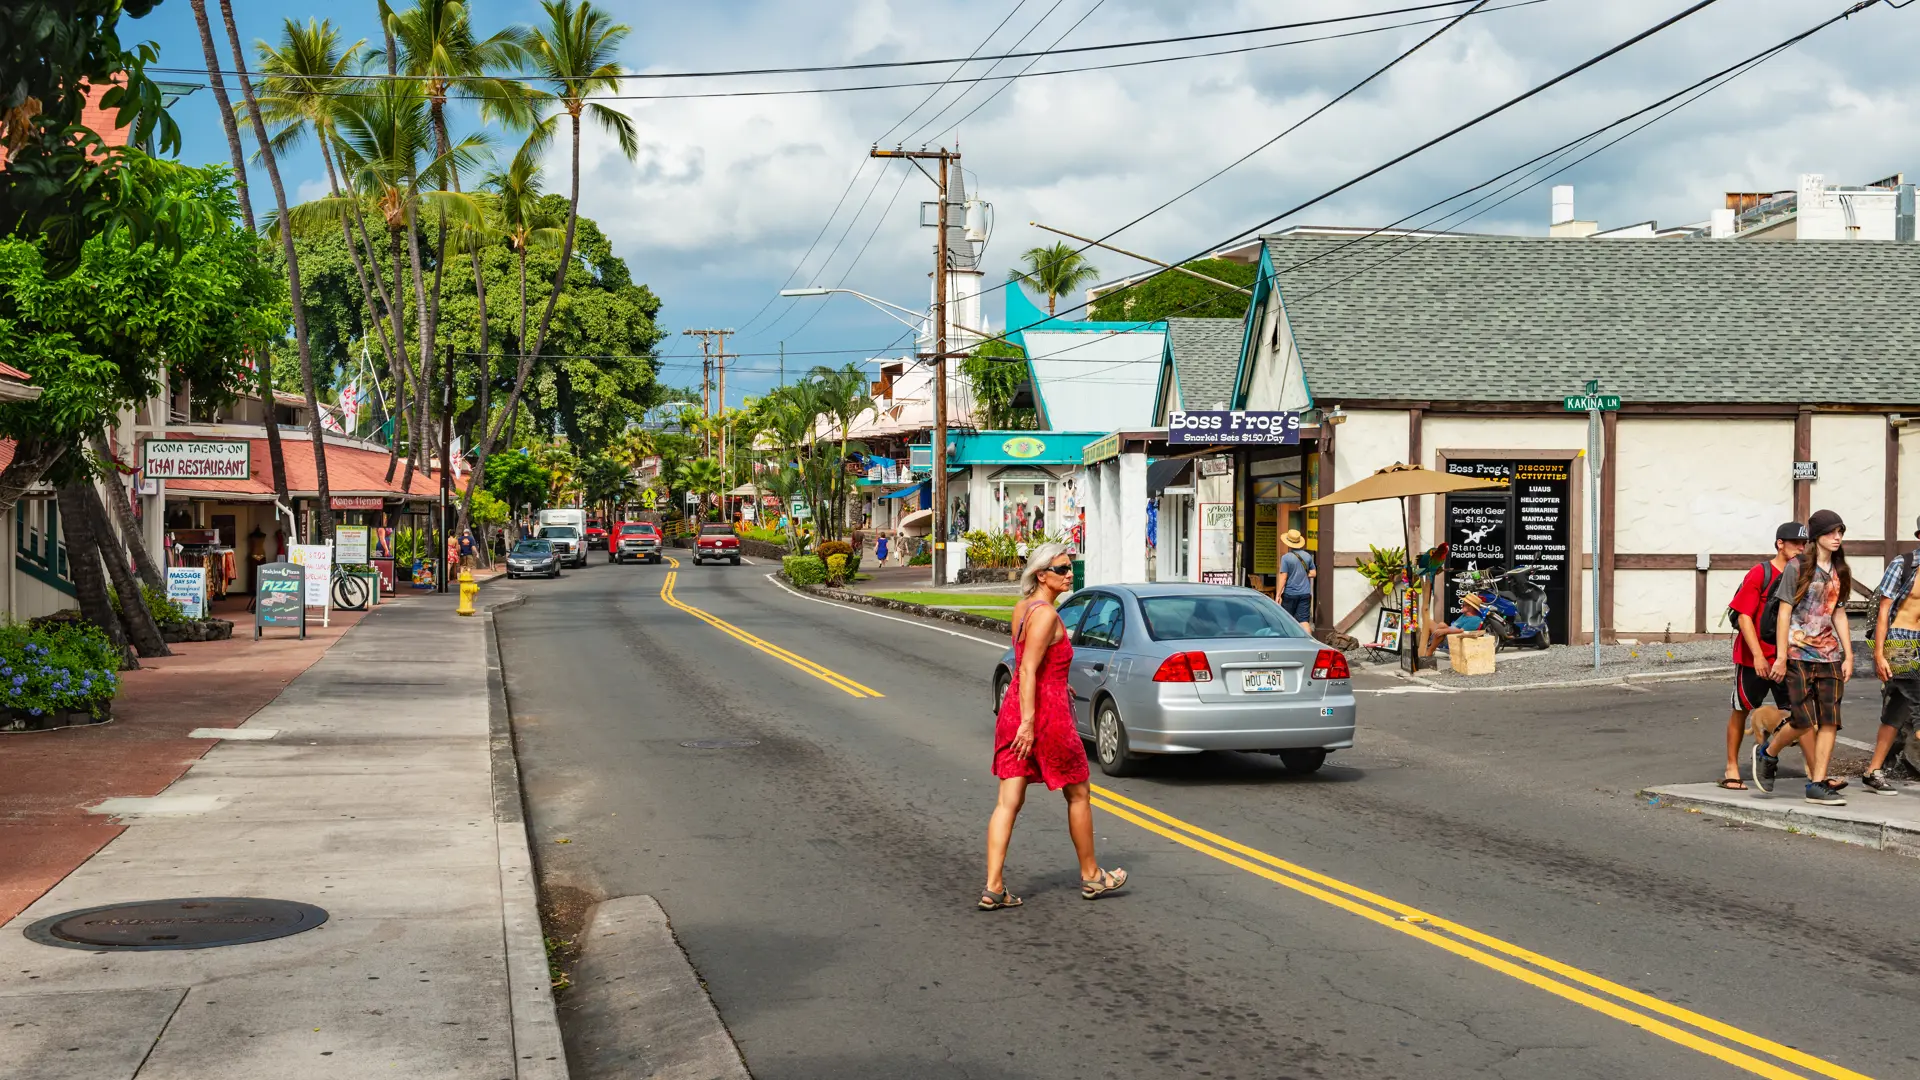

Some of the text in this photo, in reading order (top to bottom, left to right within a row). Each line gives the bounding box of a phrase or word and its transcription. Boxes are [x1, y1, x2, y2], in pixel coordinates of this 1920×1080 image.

[1567, 398, 1617, 409] KAKINA LN
[1169, 411, 1299, 435] Boss Frog's
[1183, 434, 1218, 442] Snorkel
[1220, 434, 1240, 442] Sets
[152, 443, 244, 454] KONA TAENG-ON
[148, 457, 247, 477] THAI RESTAURANT
[1449, 464, 1509, 476] Boss Frog's
[332, 496, 354, 506] Kona
[794, 504, 803, 515] P
[1452, 507, 1506, 515] Snorkel Gear
[1452, 544, 1501, 552] Stand-Up
[261, 580, 299, 592] PIZZA
[1204, 577, 1233, 585] TATTOO
[1266, 674, 1281, 686] 487
